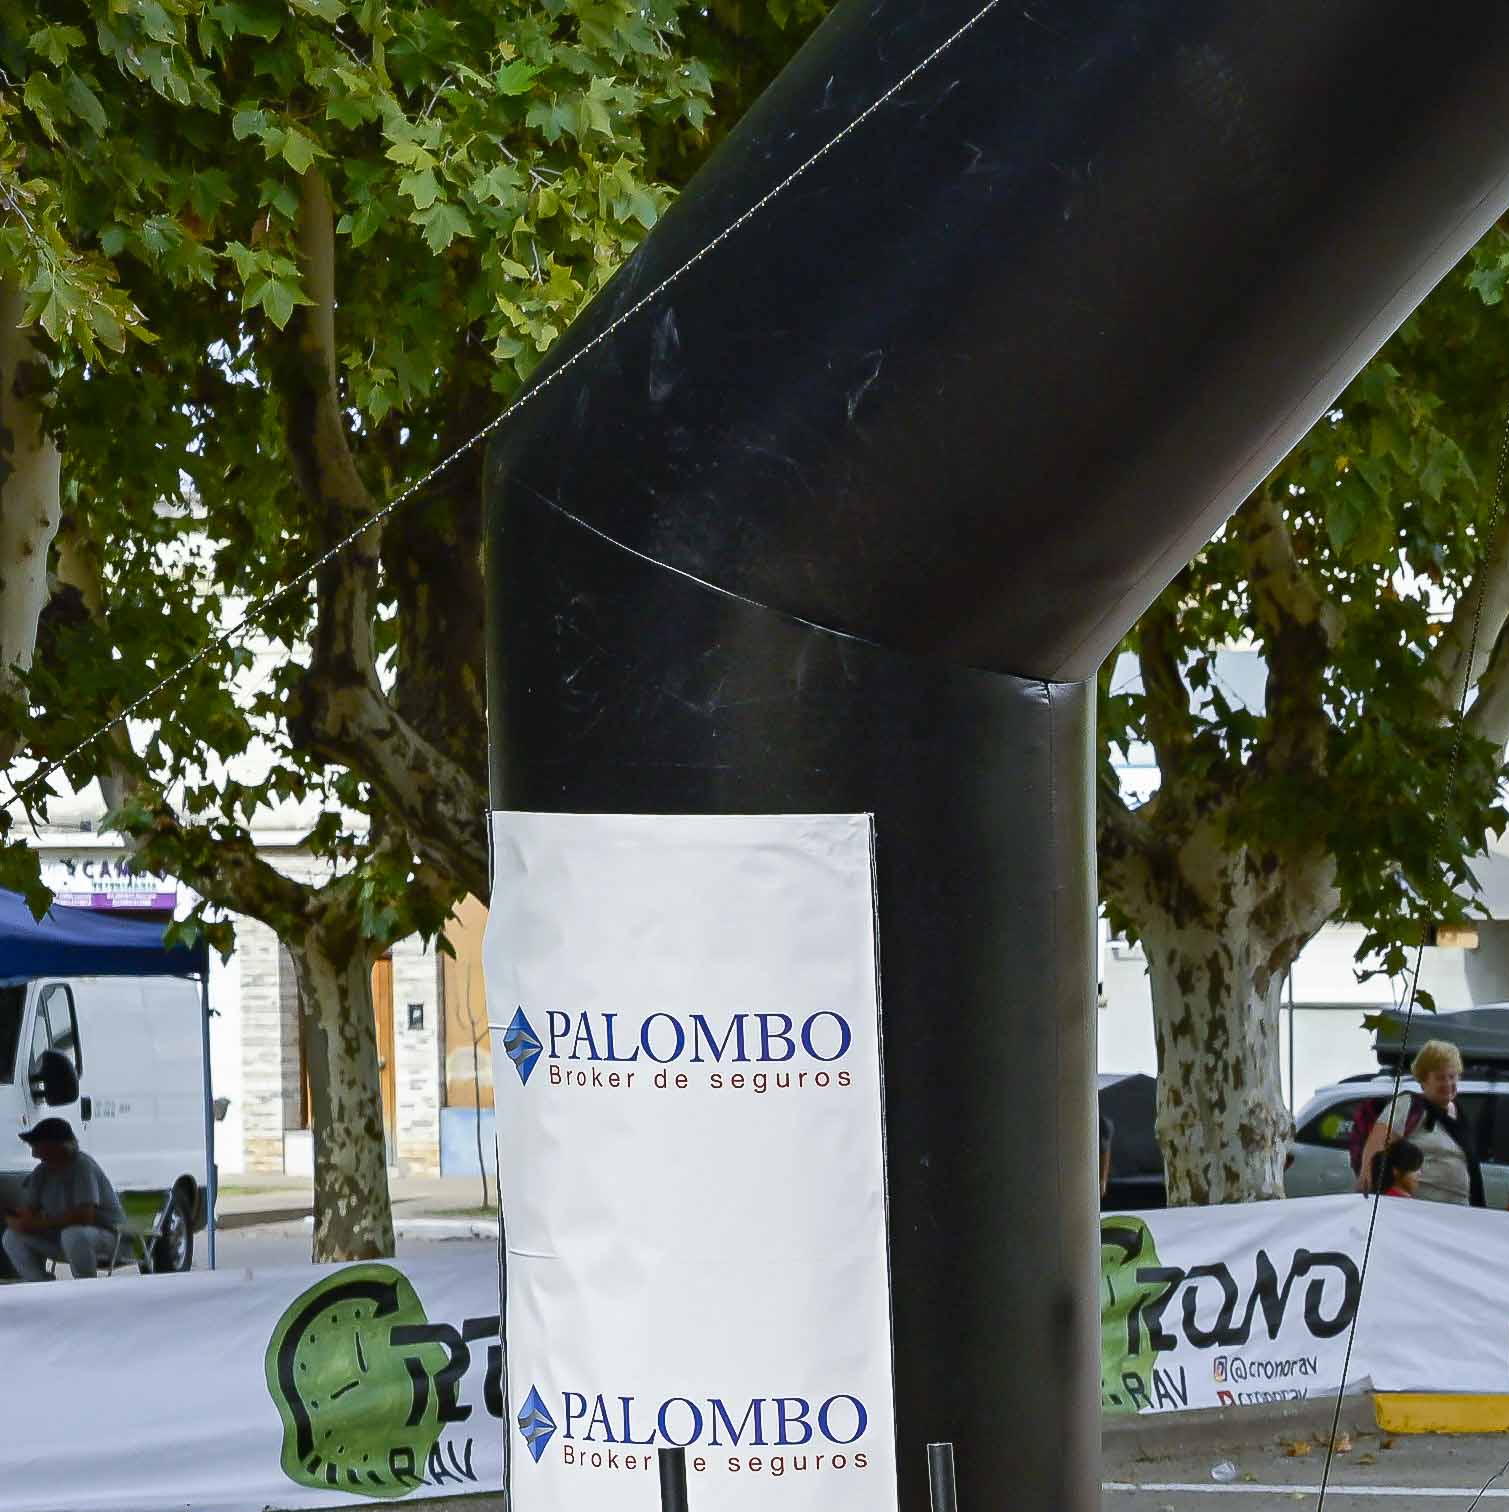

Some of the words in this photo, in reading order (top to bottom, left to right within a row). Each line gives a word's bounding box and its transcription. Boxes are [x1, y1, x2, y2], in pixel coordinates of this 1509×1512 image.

[545, 1010, 852, 1064] PALOMBO
[549, 1064, 635, 1089] Broker
[653, 1067, 689, 1090] de
[710, 1069, 853, 1093] seguros
[561, 1391, 868, 1447] PALOMBO
[563, 1445, 652, 1471] Broker
[728, 1451, 868, 1477] seguros
